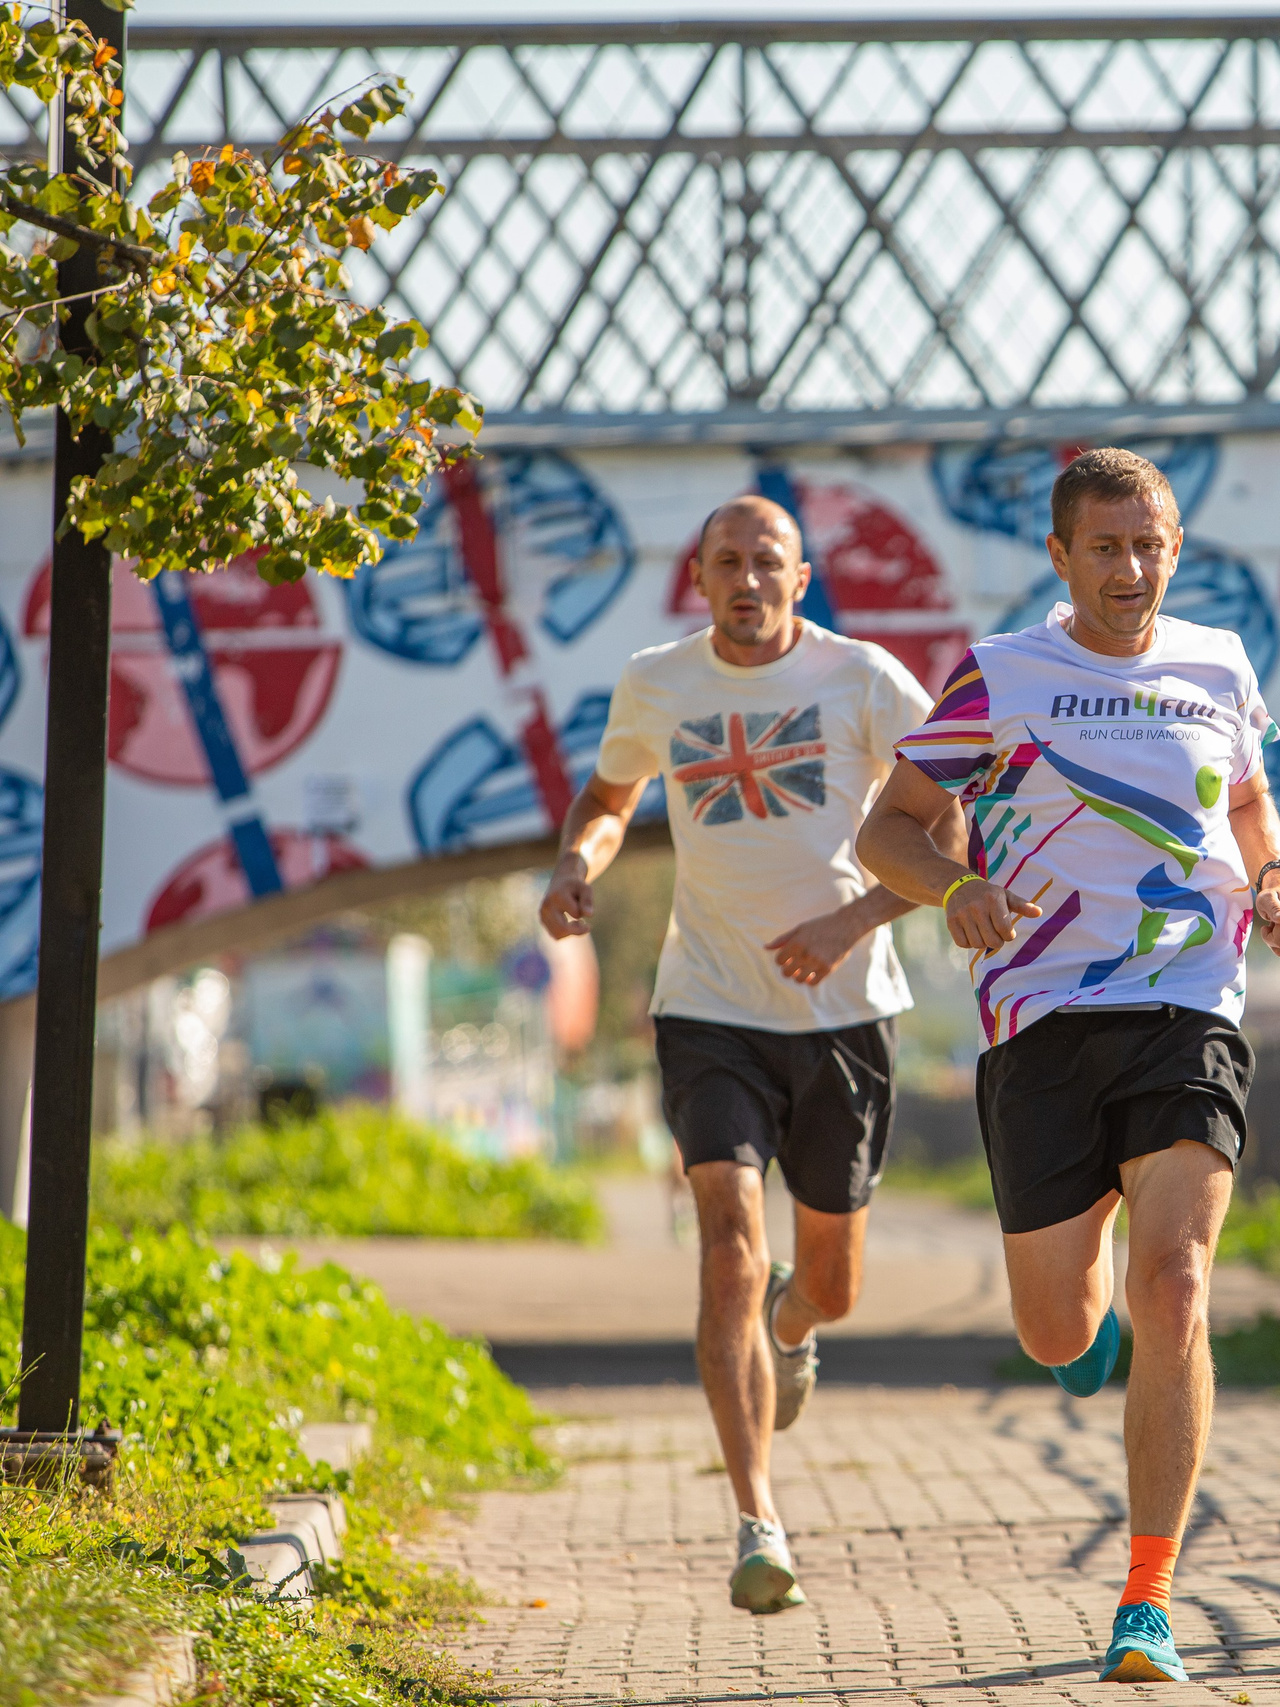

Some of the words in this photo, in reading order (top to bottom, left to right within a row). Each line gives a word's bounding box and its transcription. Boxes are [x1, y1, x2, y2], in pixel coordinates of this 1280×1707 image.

[1079, 729, 1108, 741] RUN
[1110, 728, 1144, 741] CLUB
[1146, 729, 1201, 741] IVANOVO
